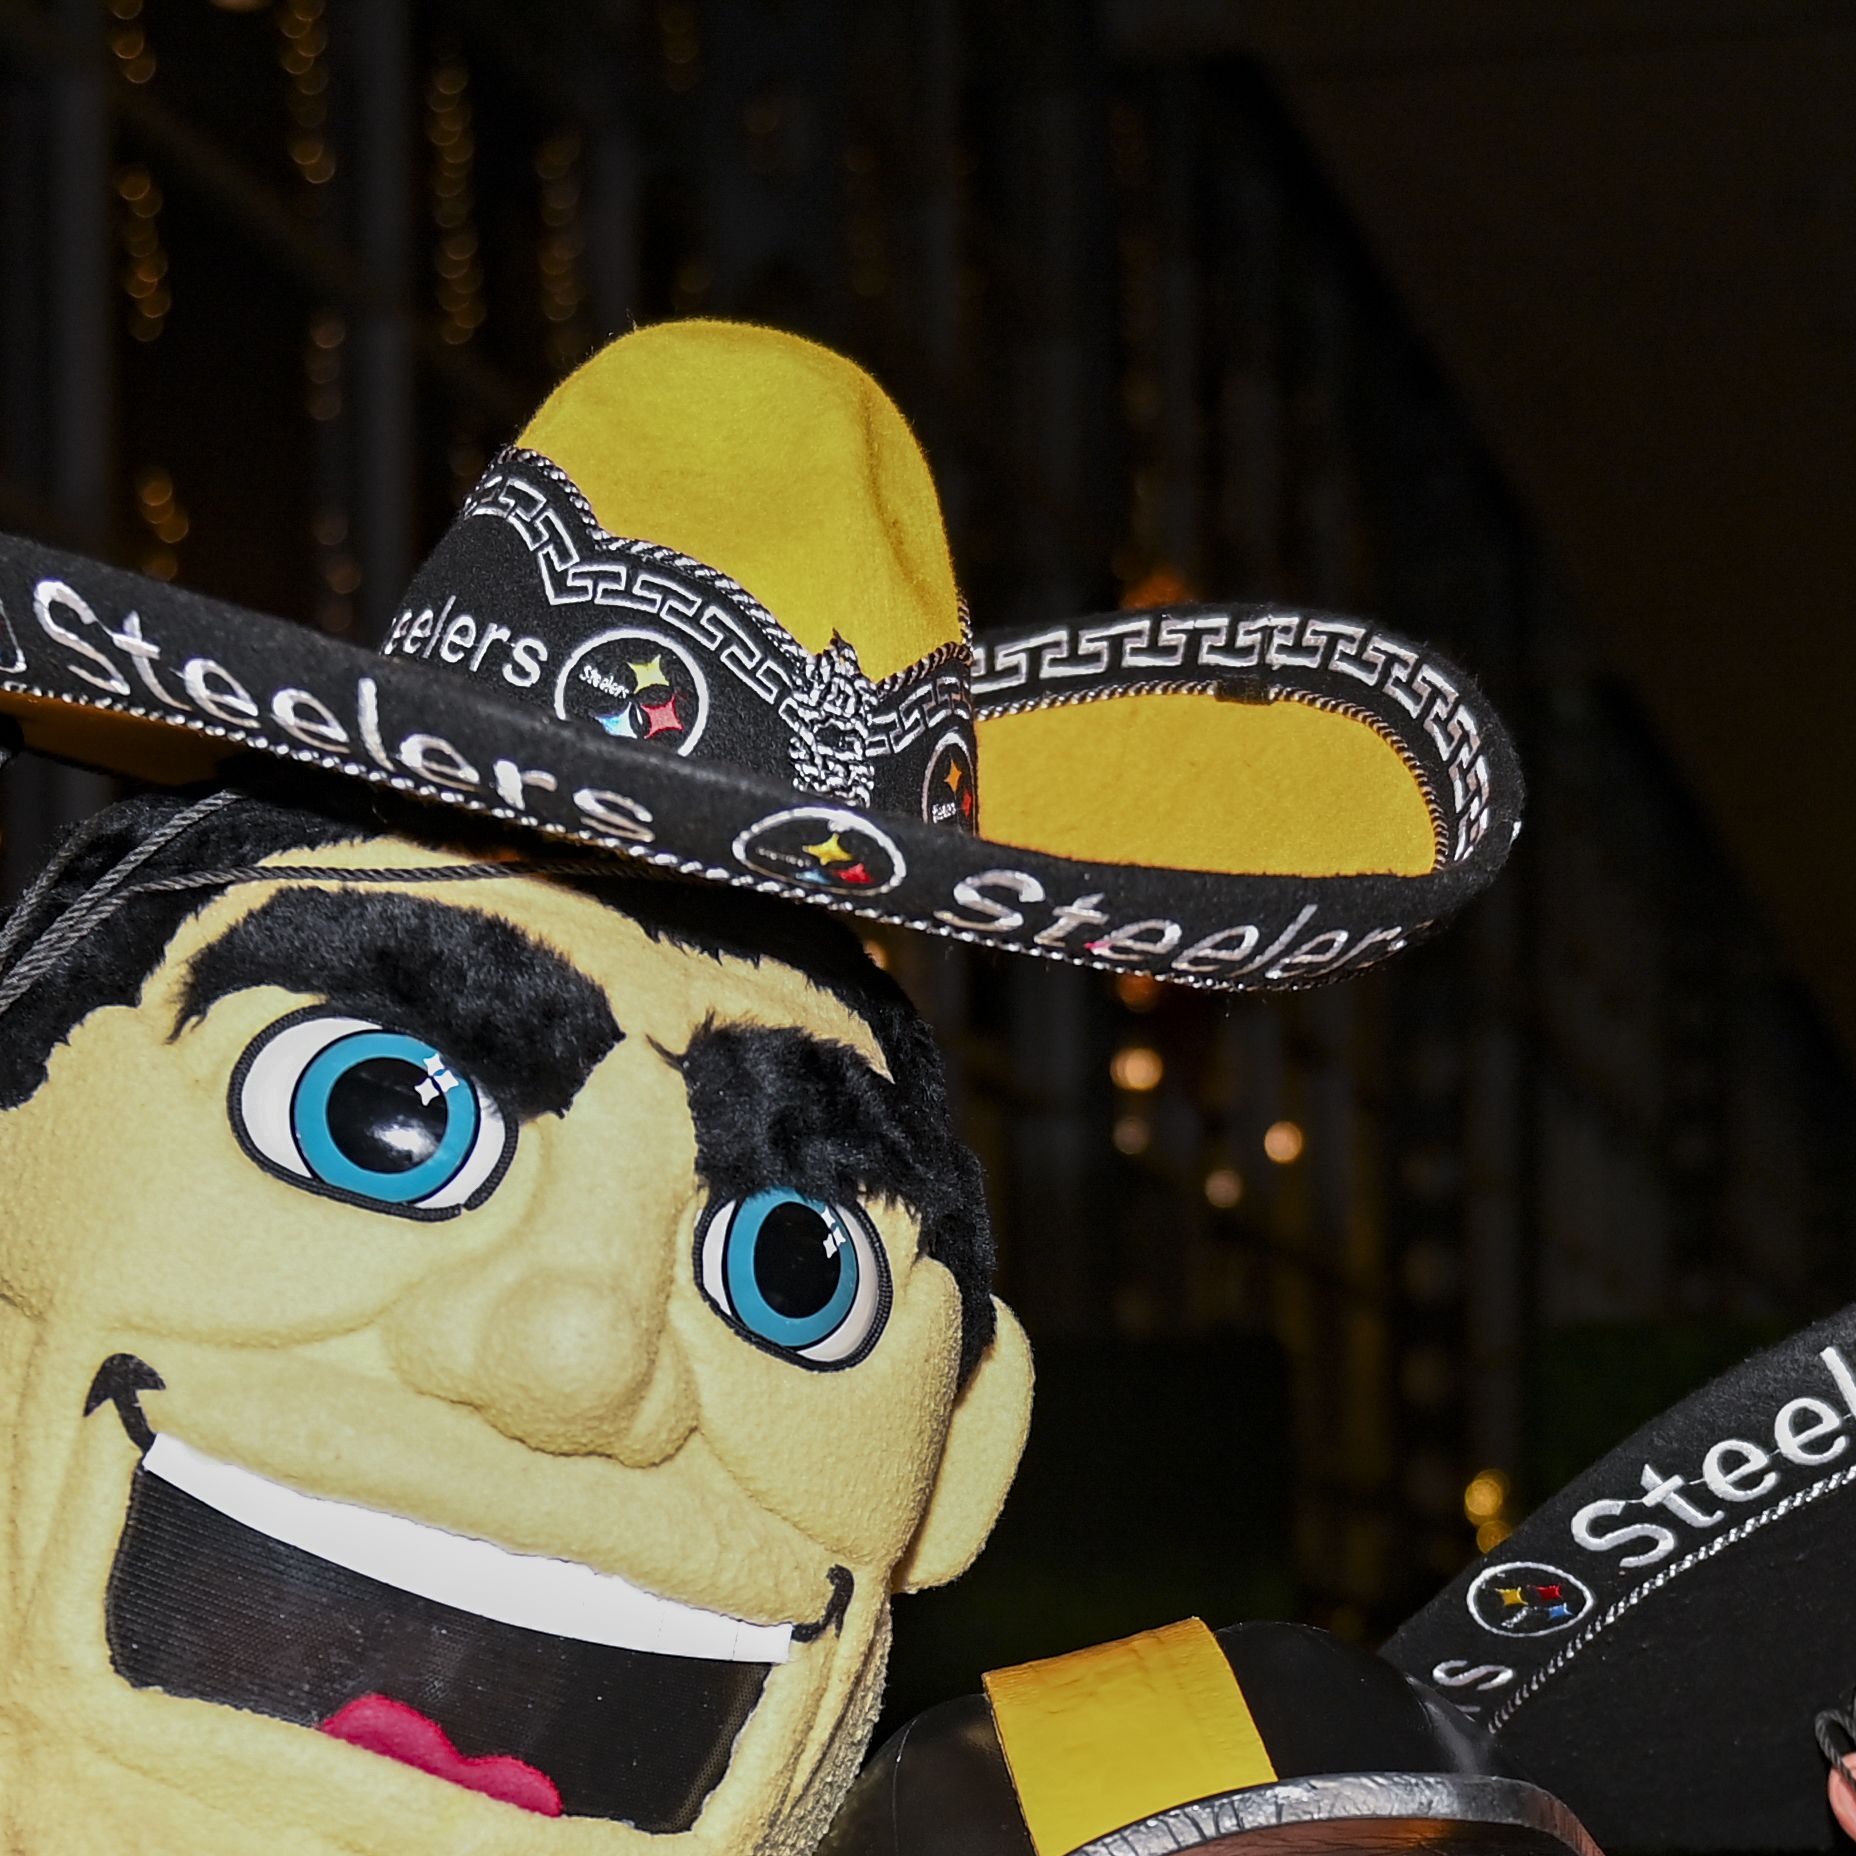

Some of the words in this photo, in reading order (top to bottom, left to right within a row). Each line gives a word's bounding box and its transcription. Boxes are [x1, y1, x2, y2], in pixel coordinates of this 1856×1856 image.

[380, 594, 548, 688] eelers
[33, 577, 656, 844] Steelers
[933, 868, 1430, 981] Steeler
